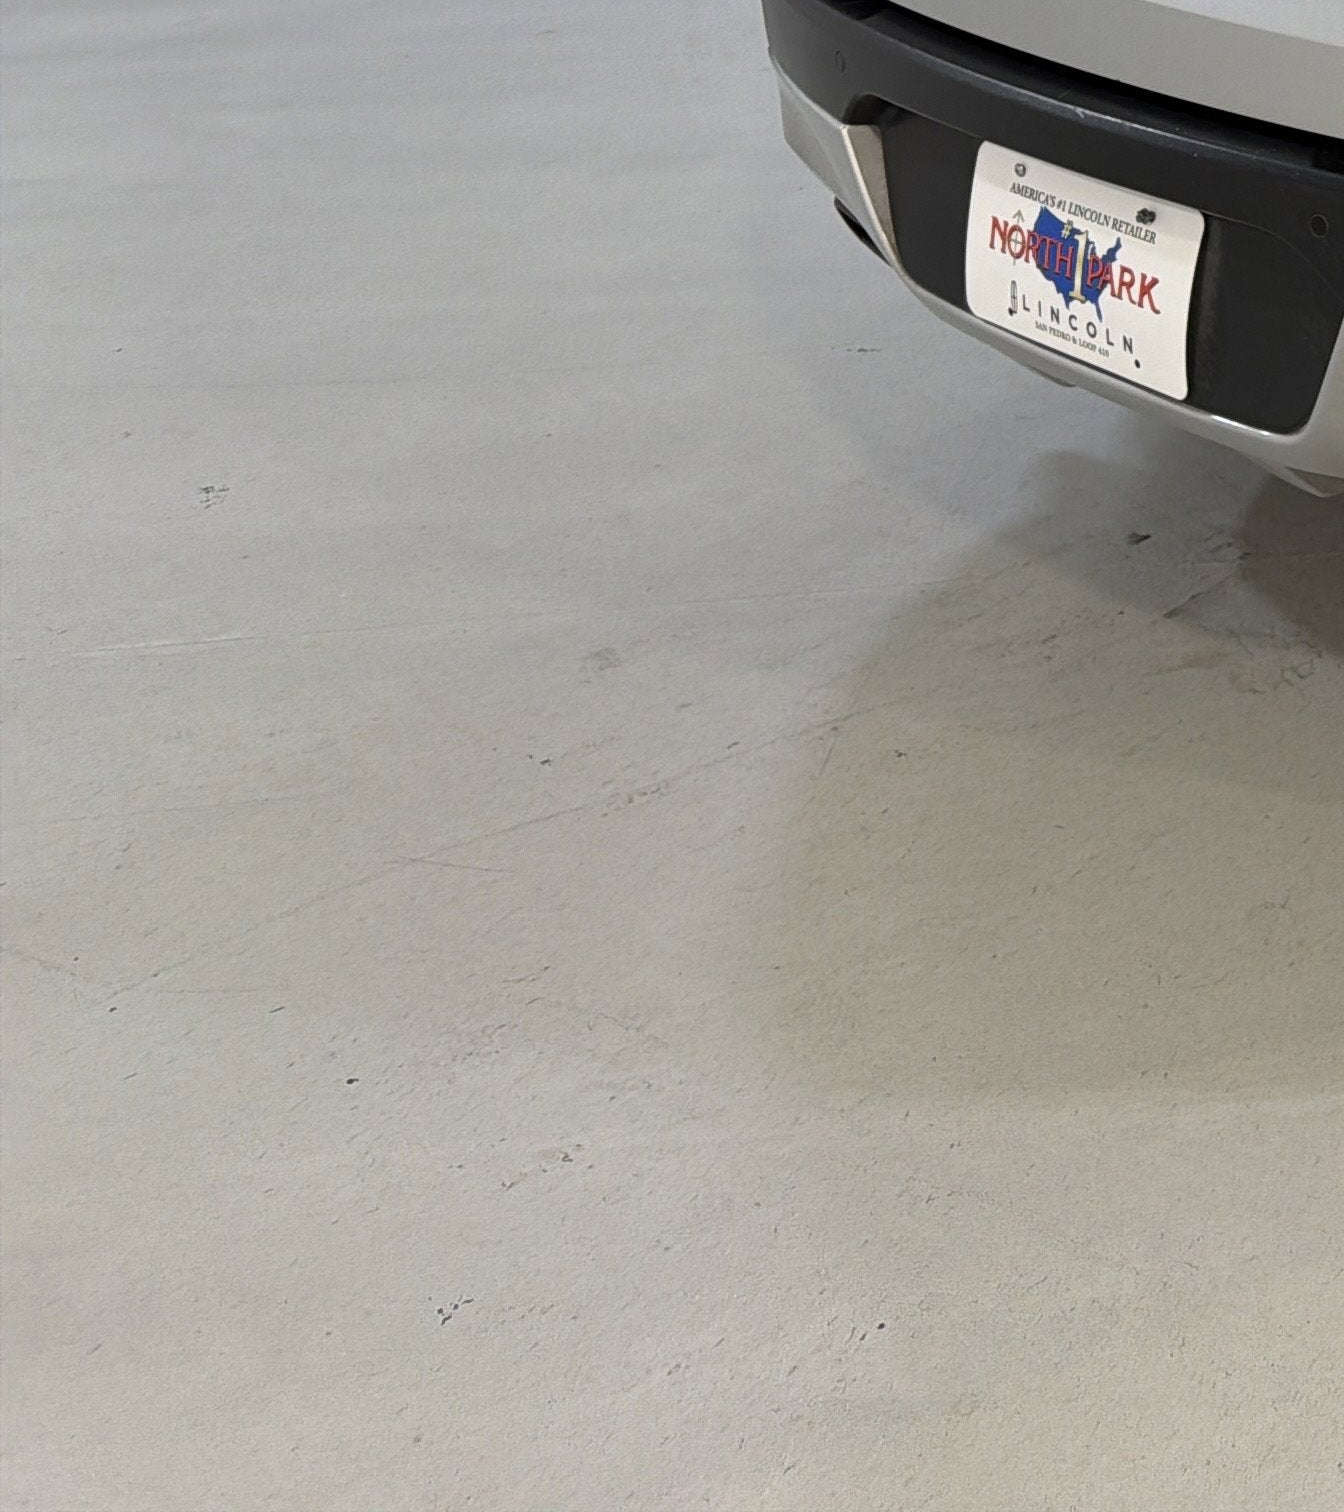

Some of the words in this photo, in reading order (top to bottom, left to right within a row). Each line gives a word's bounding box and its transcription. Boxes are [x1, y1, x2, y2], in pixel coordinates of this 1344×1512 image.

[1010, 182, 1056, 209] AMERICA'S
[1056, 199, 1067, 213] #1
[1067, 202, 1112, 229] LINCOLN
[1112, 217, 1157, 245] RETAILER
[989, 215, 1074, 279] NORTH
[1087, 254, 1161, 315] PARK
[1022, 294, 1133, 355] LINCOLN
